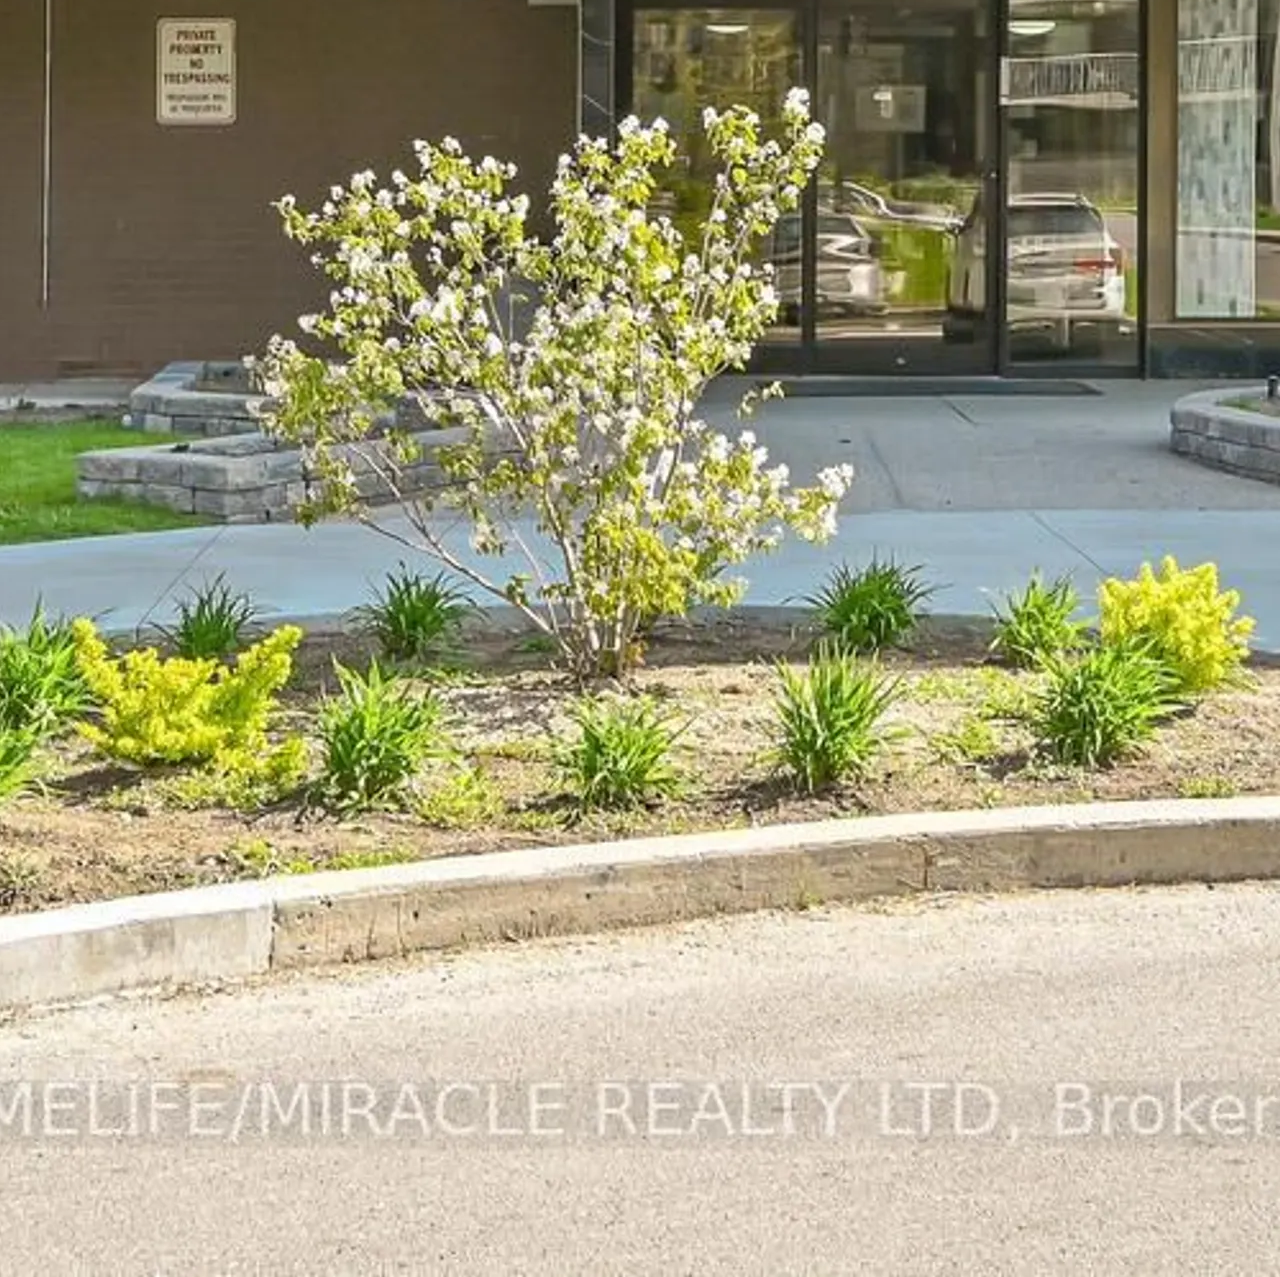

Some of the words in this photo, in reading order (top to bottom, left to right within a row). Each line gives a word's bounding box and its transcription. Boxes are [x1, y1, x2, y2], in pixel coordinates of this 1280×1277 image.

[176, 30, 217, 41] PRIVATE
[169, 43, 222, 54] PROPERTY
[189, 58, 205, 69] NO
[164, 73, 230, 85] TRESPASSING
